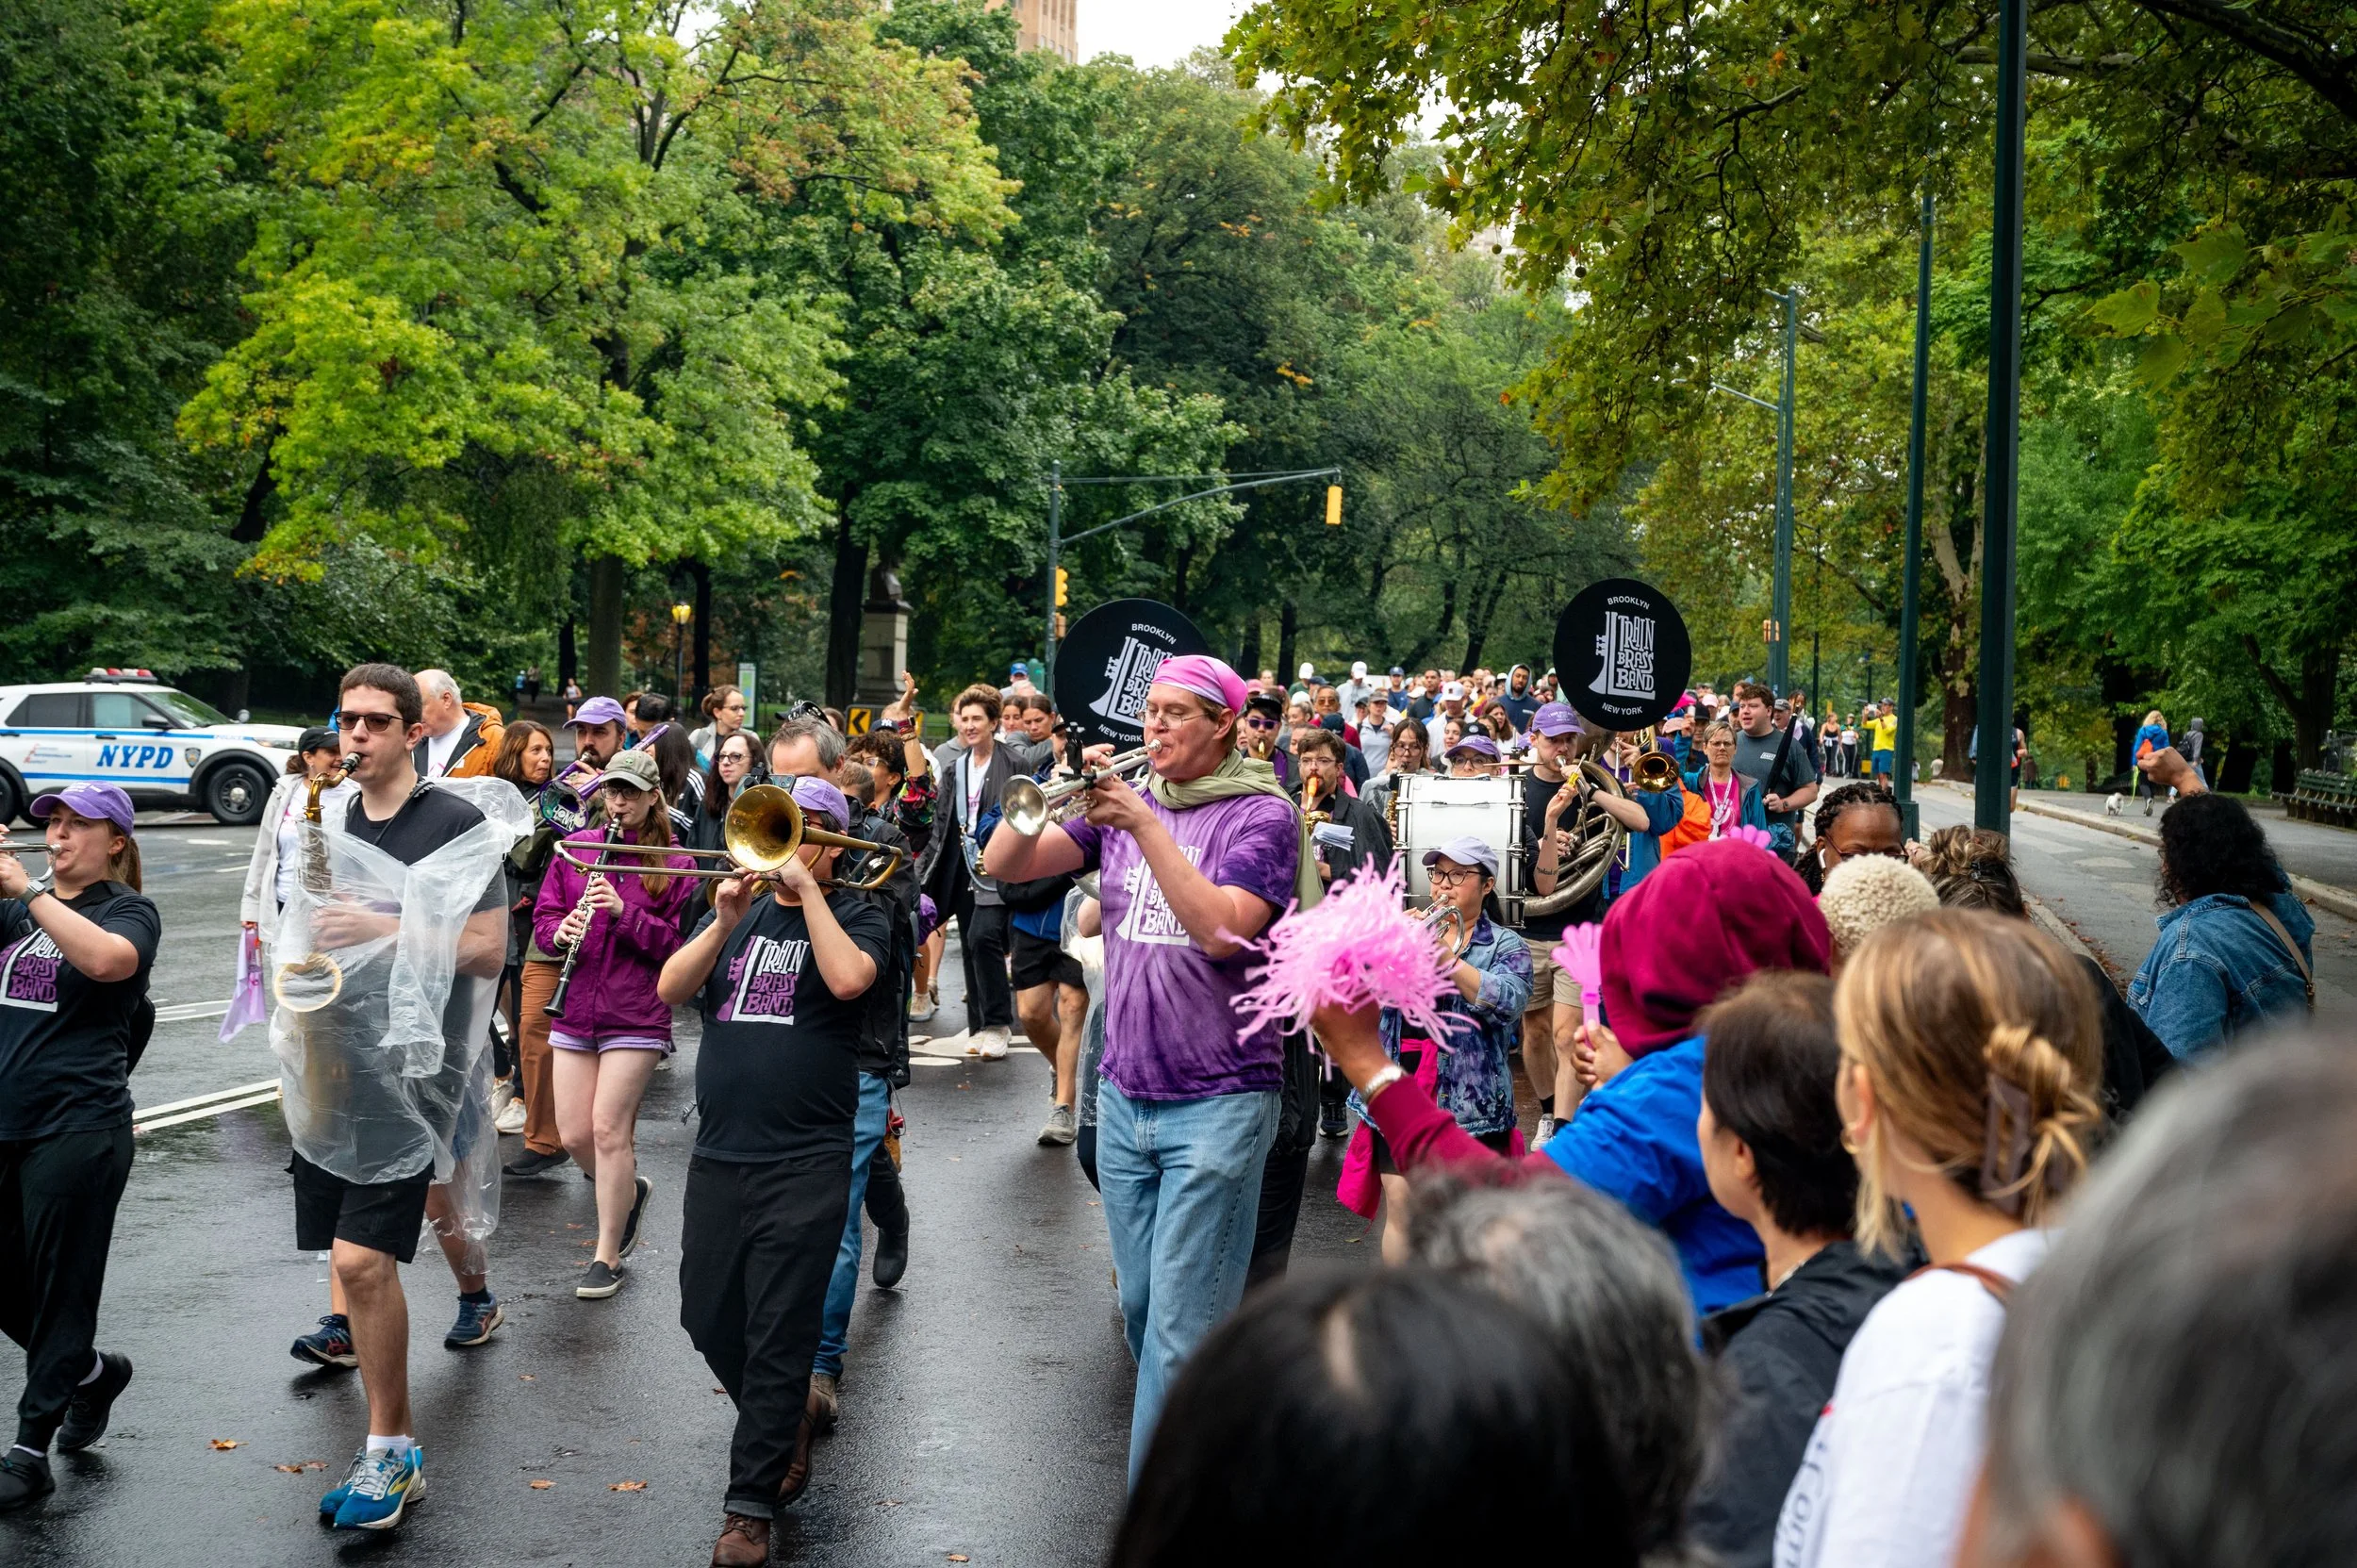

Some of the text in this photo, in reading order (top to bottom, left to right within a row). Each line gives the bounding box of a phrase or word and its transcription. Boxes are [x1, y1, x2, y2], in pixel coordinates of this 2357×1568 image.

[1607, 596, 1650, 609] BROOKLYN
[1131, 623, 1177, 644] BROOKLYN
[1618, 616, 1656, 652] TRAIN
[1617, 651, 1655, 674] BRASS
[1124, 677, 1151, 700] BRA
[1616, 668, 1655, 690] BAND
[1602, 702, 1642, 715] NEW YORK
[1098, 724, 1143, 742] NEW YORK
[96, 745, 173, 768] NYPD
[14, 955, 61, 982] BRASS
[755, 939, 809, 976] TRAIN
[8, 975, 57, 1001] BAND
[750, 973, 799, 996] BRASS
[743, 993, 794, 1015] BAND
